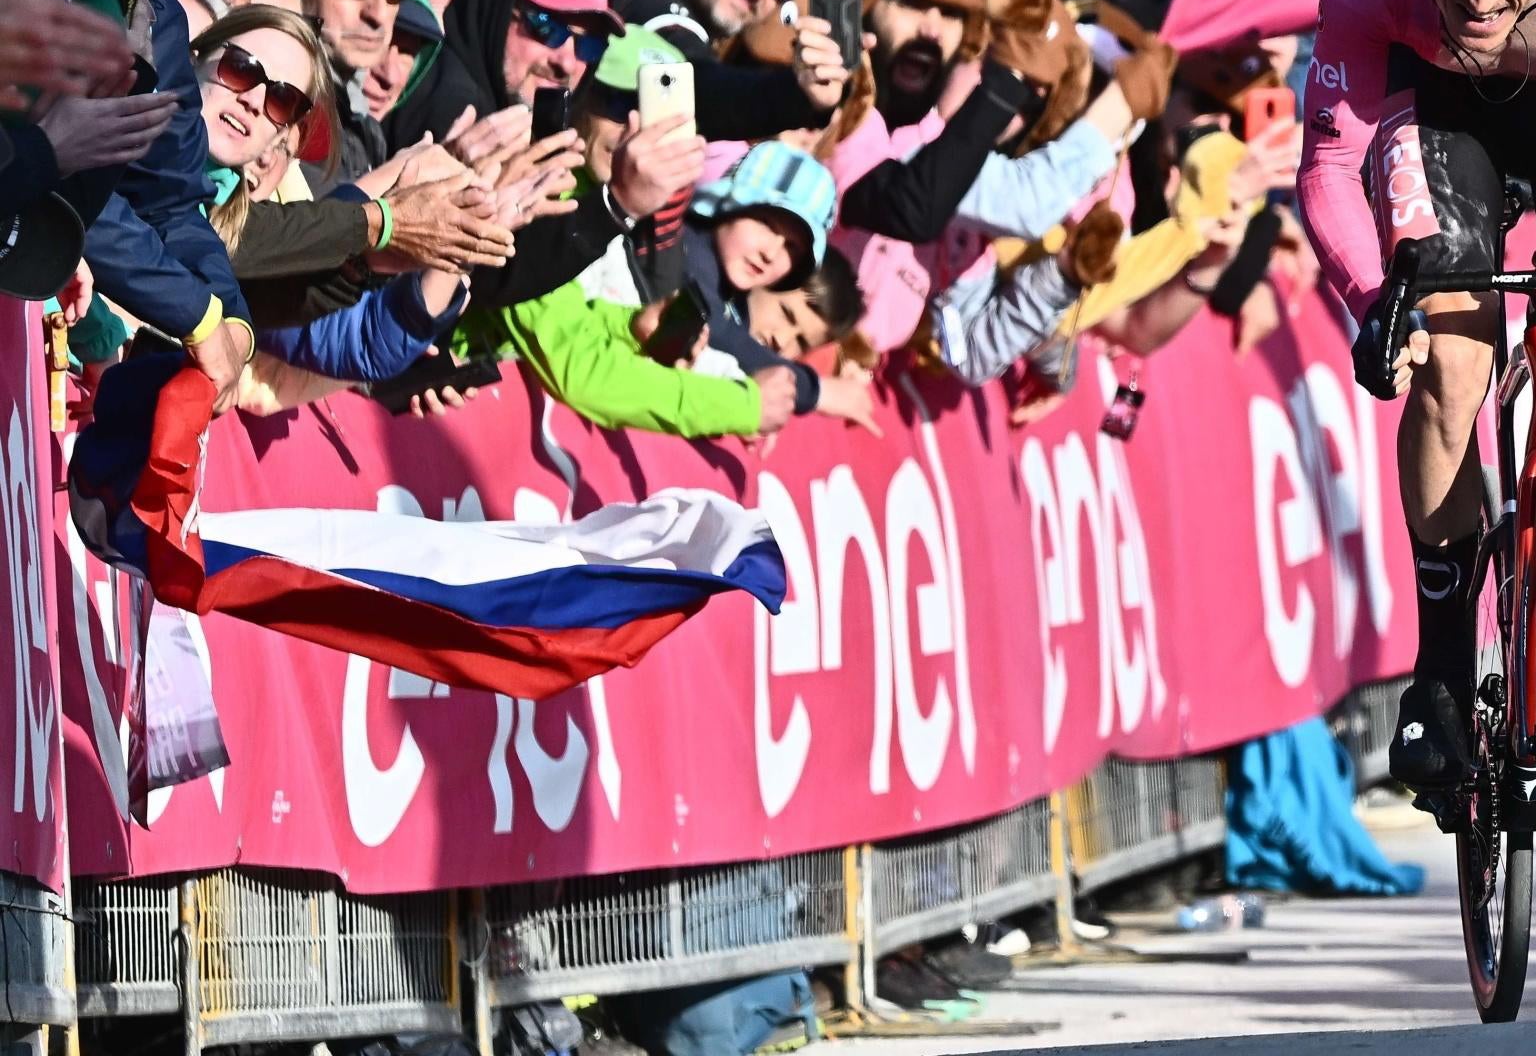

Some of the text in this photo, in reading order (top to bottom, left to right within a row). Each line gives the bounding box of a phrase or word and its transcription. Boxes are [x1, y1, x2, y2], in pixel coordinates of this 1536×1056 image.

[1310, 56, 1349, 92] nel
[1491, 274, 1533, 284] MOST
[754, 369, 978, 820] enel
[1020, 353, 1168, 756] enel
